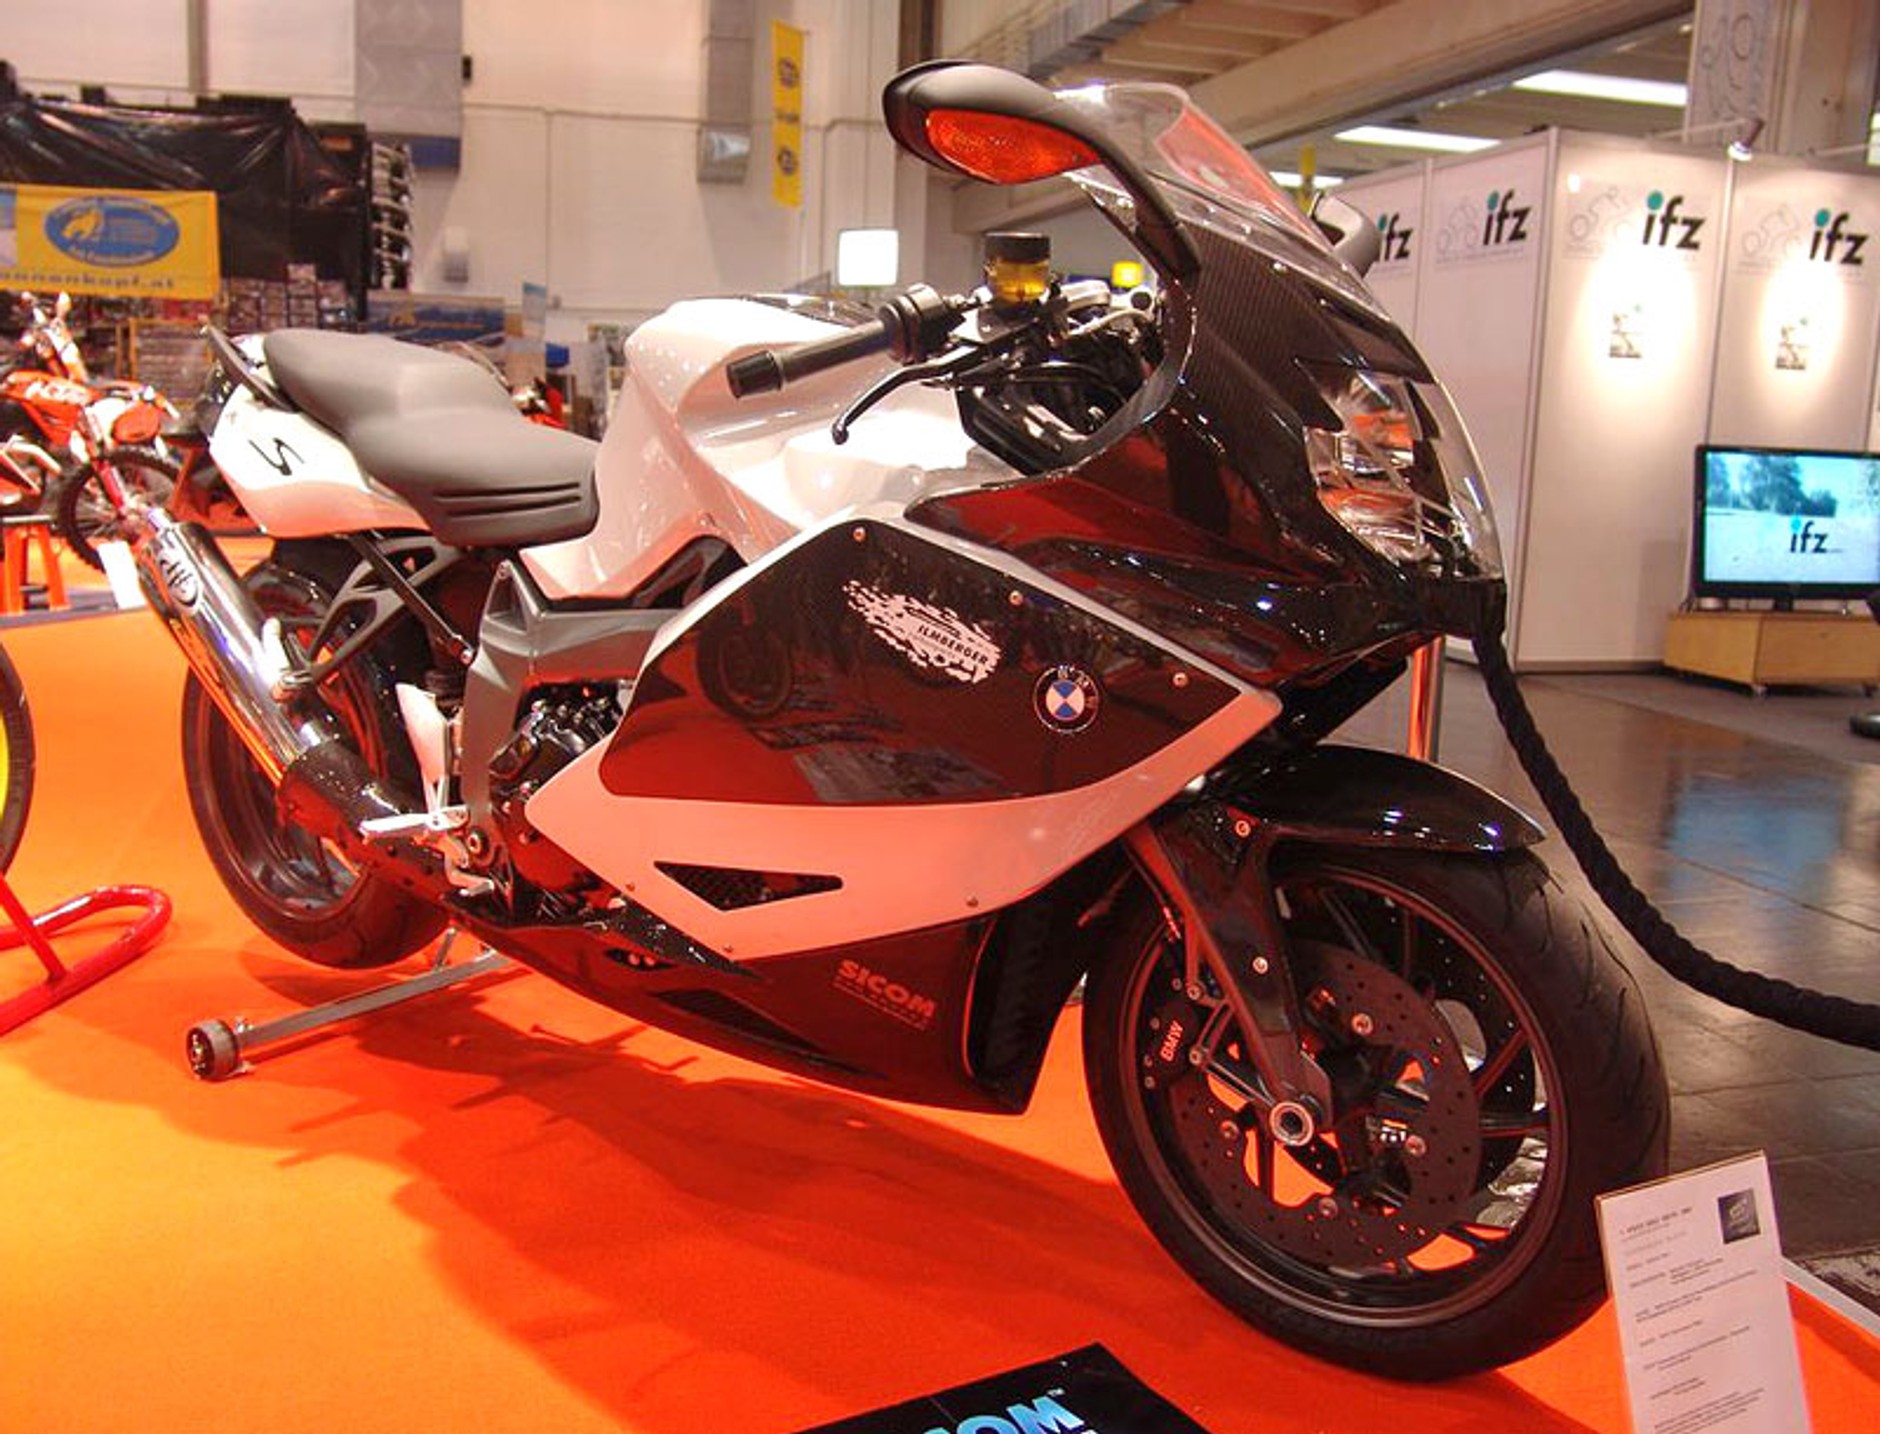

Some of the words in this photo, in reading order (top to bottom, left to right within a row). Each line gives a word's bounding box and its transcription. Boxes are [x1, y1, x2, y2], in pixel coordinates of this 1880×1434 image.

[1484, 188, 1532, 246] ifz
[1642, 189, 1706, 251] ifz
[1808, 207, 1868, 266] ifz
[1789, 518, 1829, 553] ifz
[918, 623, 989, 665] ILMBERGER
[838, 959, 936, 1018] SICOM
[1159, 1019, 1184, 1062] BMW
